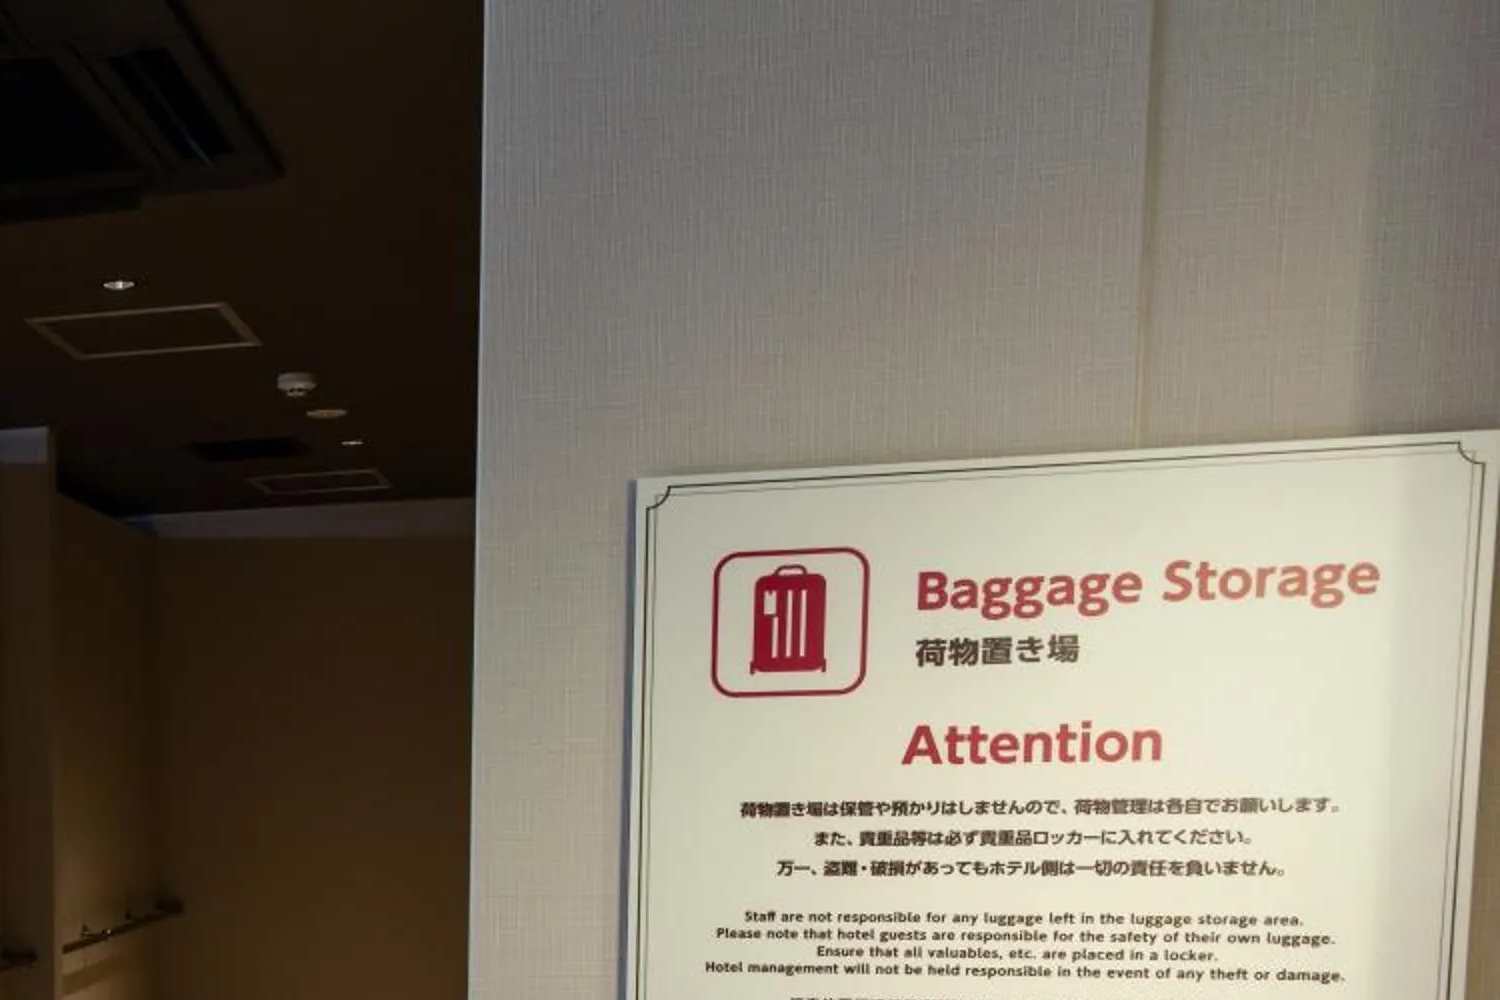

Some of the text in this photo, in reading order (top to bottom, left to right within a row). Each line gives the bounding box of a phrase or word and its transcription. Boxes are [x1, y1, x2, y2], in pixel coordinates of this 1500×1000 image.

[917, 560, 1380, 620] Baggage Storage
[915, 634, 1080, 668] 荷物置き場
[901, 720, 1162, 765] Attention
[744, 910, 1303, 929] Staff are not responsible for any luggage left in the luggage storage area.
[716, 927, 1335, 947] Please note that hotel guests are responsible for the safety of their own luggage.
[816, 945, 1218, 963] Ensure that all valuables, etc. are placed in a locker.
[705, 961, 1345, 985] Hotel management will not be held responsible in the event of any theft or damage.
